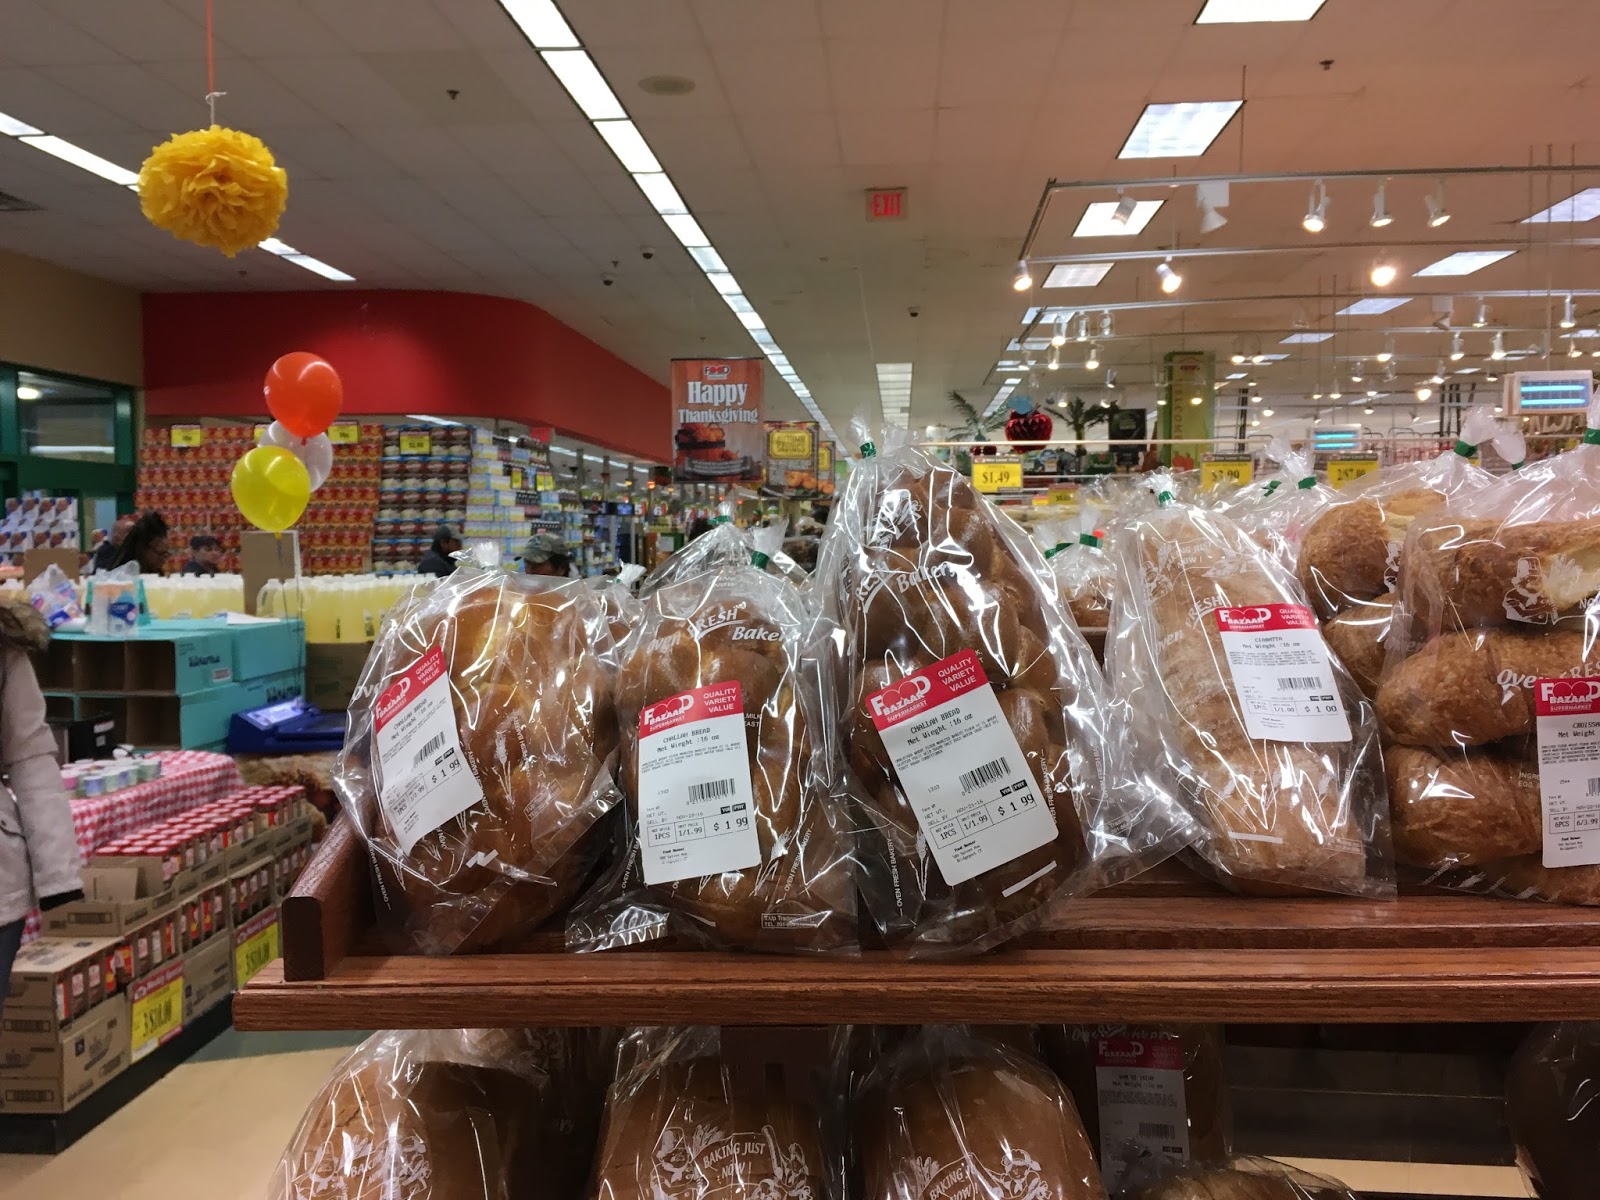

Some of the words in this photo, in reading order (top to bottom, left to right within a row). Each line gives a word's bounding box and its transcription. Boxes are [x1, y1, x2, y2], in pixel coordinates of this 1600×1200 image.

[874, 192, 900, 216] EXIT
[688, 382, 748, 406] Happy
[678, 408, 758, 424] Thanksgiving
[982, 472, 1010, 484] $1.49
[1219, 608, 1271, 622] FOOD
[415, 652, 440, 675] QUALITY
[417, 659, 441, 681] VARIETY
[938, 657, 972, 677] QUALITY
[421, 668, 440, 685] VALUE
[942, 665, 976, 686] VARIETY
[949, 675, 976, 693] VALUE
[1497, 669, 1541, 689] Ove
[375, 676, 411, 721] FOOD
[703, 688, 736, 699] QUALITY
[704, 696, 736, 706] VARIETY
[871, 676, 931, 717] FOOD
[1541, 681, 1600, 701] FOOD
[644, 694, 694, 726] FOOD
[708, 704, 734, 713] VALUE
[883, 693, 924, 715] BAZAAR
[886, 700, 928, 722] SUPERMARKET
[650, 709, 685, 725] BAZAAR
[910, 714, 938, 734] CHALLAH
[940, 707, 960, 722] BREAD
[663, 730, 689, 743] CHALLAH
[692, 728, 711, 738] BREAD
[907, 735, 920, 745] Net
[964, 713, 973, 722] oz
[449, 759, 460, 770] 99
[678, 827, 702, 836] 1/1.99
[713, 823, 719, 832] $
[726, 821, 730, 829] 1
[735, 817, 748, 828] 99
[940, 829, 957, 840] 1PCS
[964, 815, 988, 830] 1/1.99
[997, 806, 1005, 816] $
[1010, 801, 1017, 811] 1
[1021, 794, 1035, 807] 99
[784, 871, 795, 892] OVEN
[801, 828, 812, 850] AKERY
[887, 838, 896, 865] BAKERY
[622, 872, 630, 888] OVEN
[891, 866, 900, 889] FRESH
[895, 889, 903, 907] OVEN
[1098, 1041, 1144, 1056] FD
[703, 1145, 741, 1169] BAKING
[742, 1142, 765, 1155] JUST
[721, 1164, 745, 1179] NOW
[929, 1168, 963, 1200] BAKING
